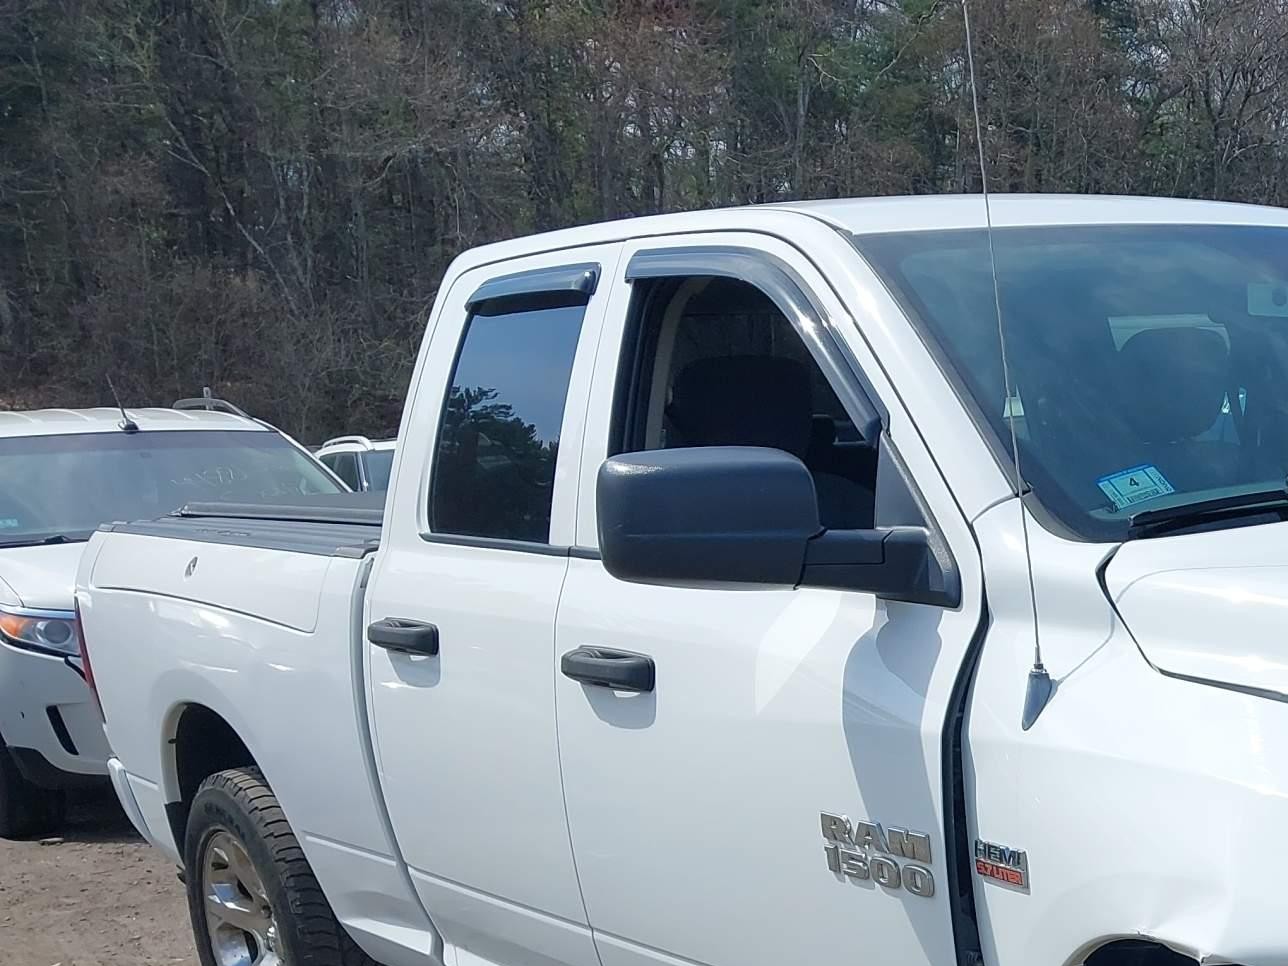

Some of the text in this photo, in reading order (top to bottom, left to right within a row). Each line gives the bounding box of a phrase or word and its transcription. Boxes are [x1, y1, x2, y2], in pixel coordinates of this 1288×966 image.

[1129, 477, 1140, 488] 4
[820, 811, 932, 865] RAM
[975, 840, 1023, 868] HEMI
[824, 843, 935, 898] 1500
